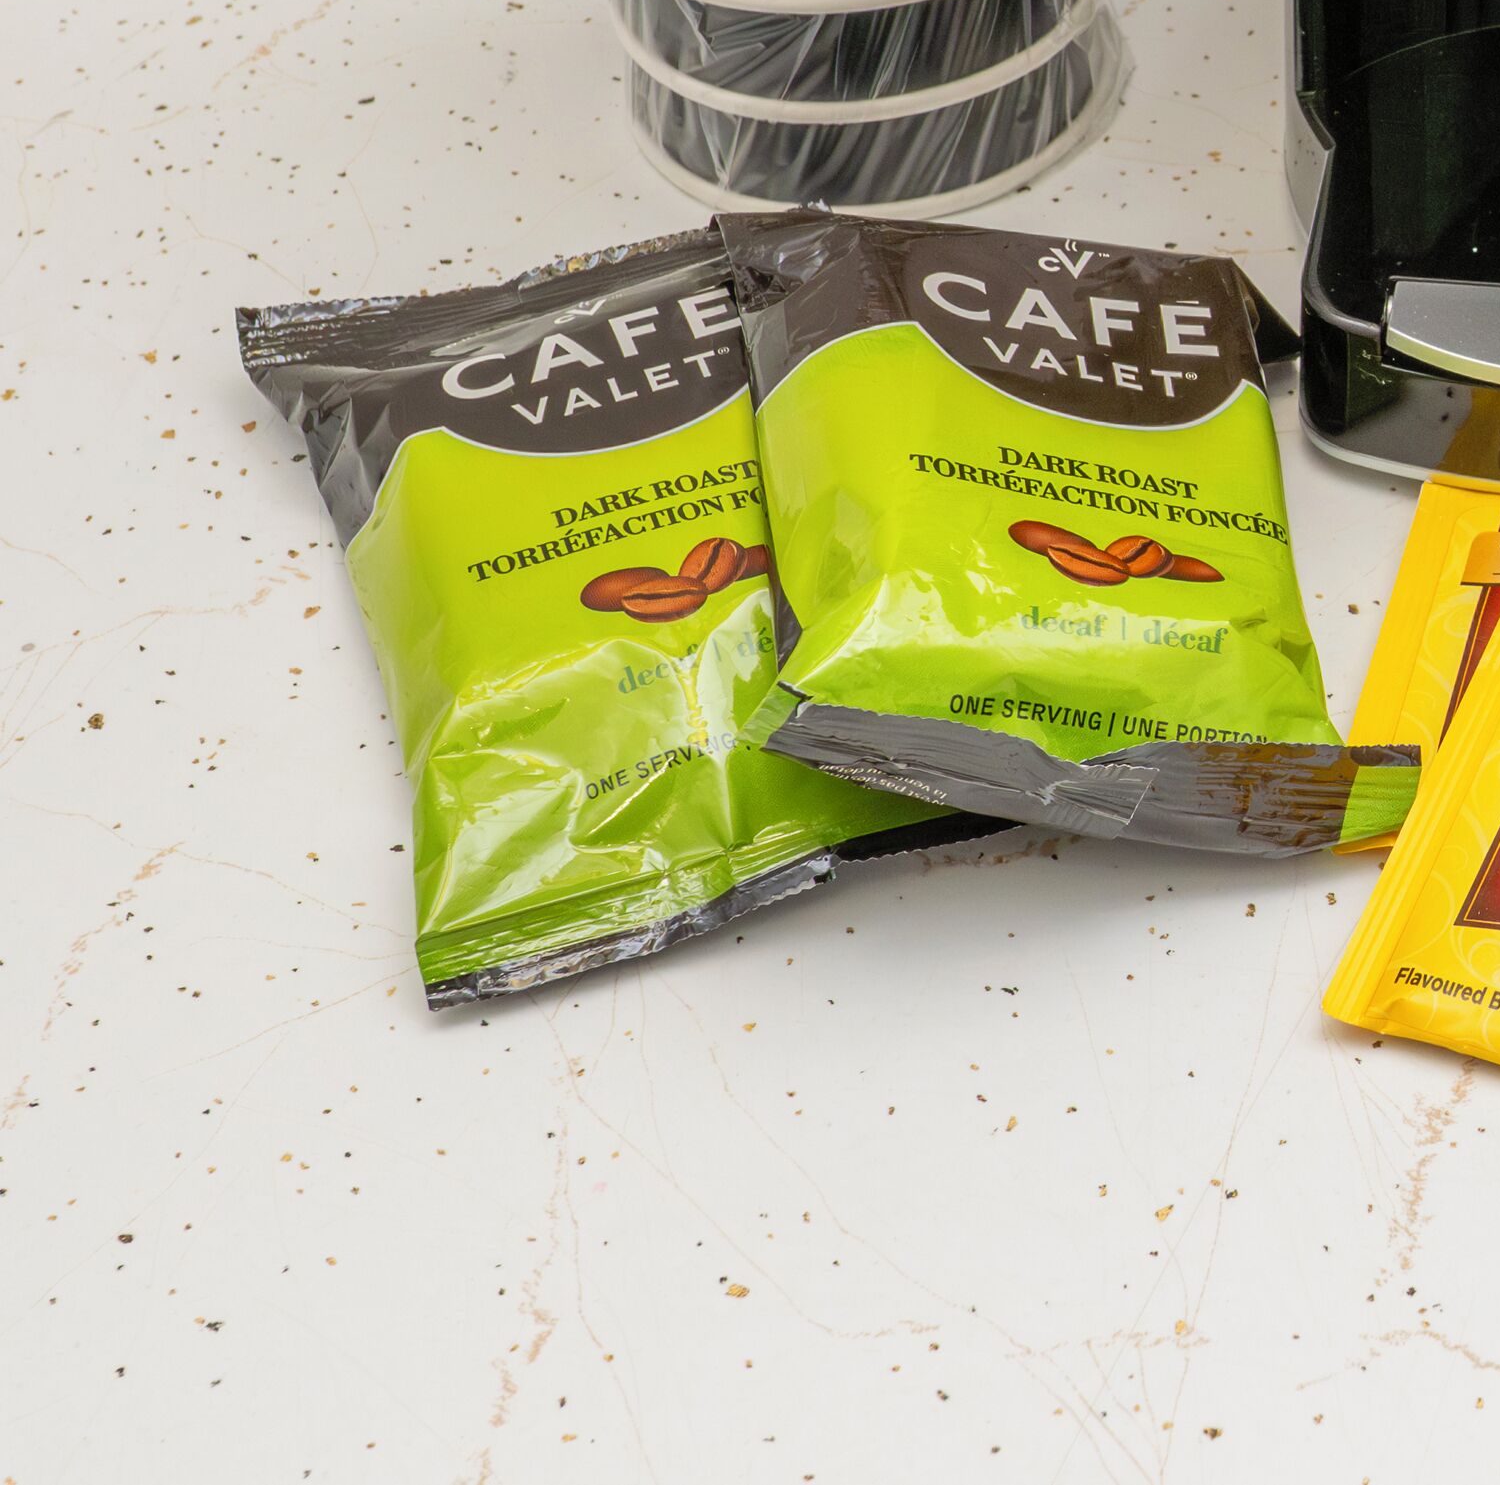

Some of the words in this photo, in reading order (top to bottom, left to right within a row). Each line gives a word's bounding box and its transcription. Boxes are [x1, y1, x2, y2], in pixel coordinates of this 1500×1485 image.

[550, 487, 650, 529] DARK
[648, 459, 760, 501] ROAST
[908, 452, 1161, 520] TORRÉFACTION
[1163, 503, 1289, 547] FONCÉE
[996, 445, 1093, 481] DARK
[1093, 463, 1199, 501] ROAST
[467, 494, 725, 583] TORRÉFACTION
[1018, 605, 1110, 638] decaf
[1142, 618, 1230, 655] décaf
[949, 693, 996, 717] ONE
[1000, 698, 1103, 731] SERVING
[1121, 715, 1169, 742] UNE
[584, 768, 630, 800] ONE
[1393, 966, 1488, 1006] Flavoured
